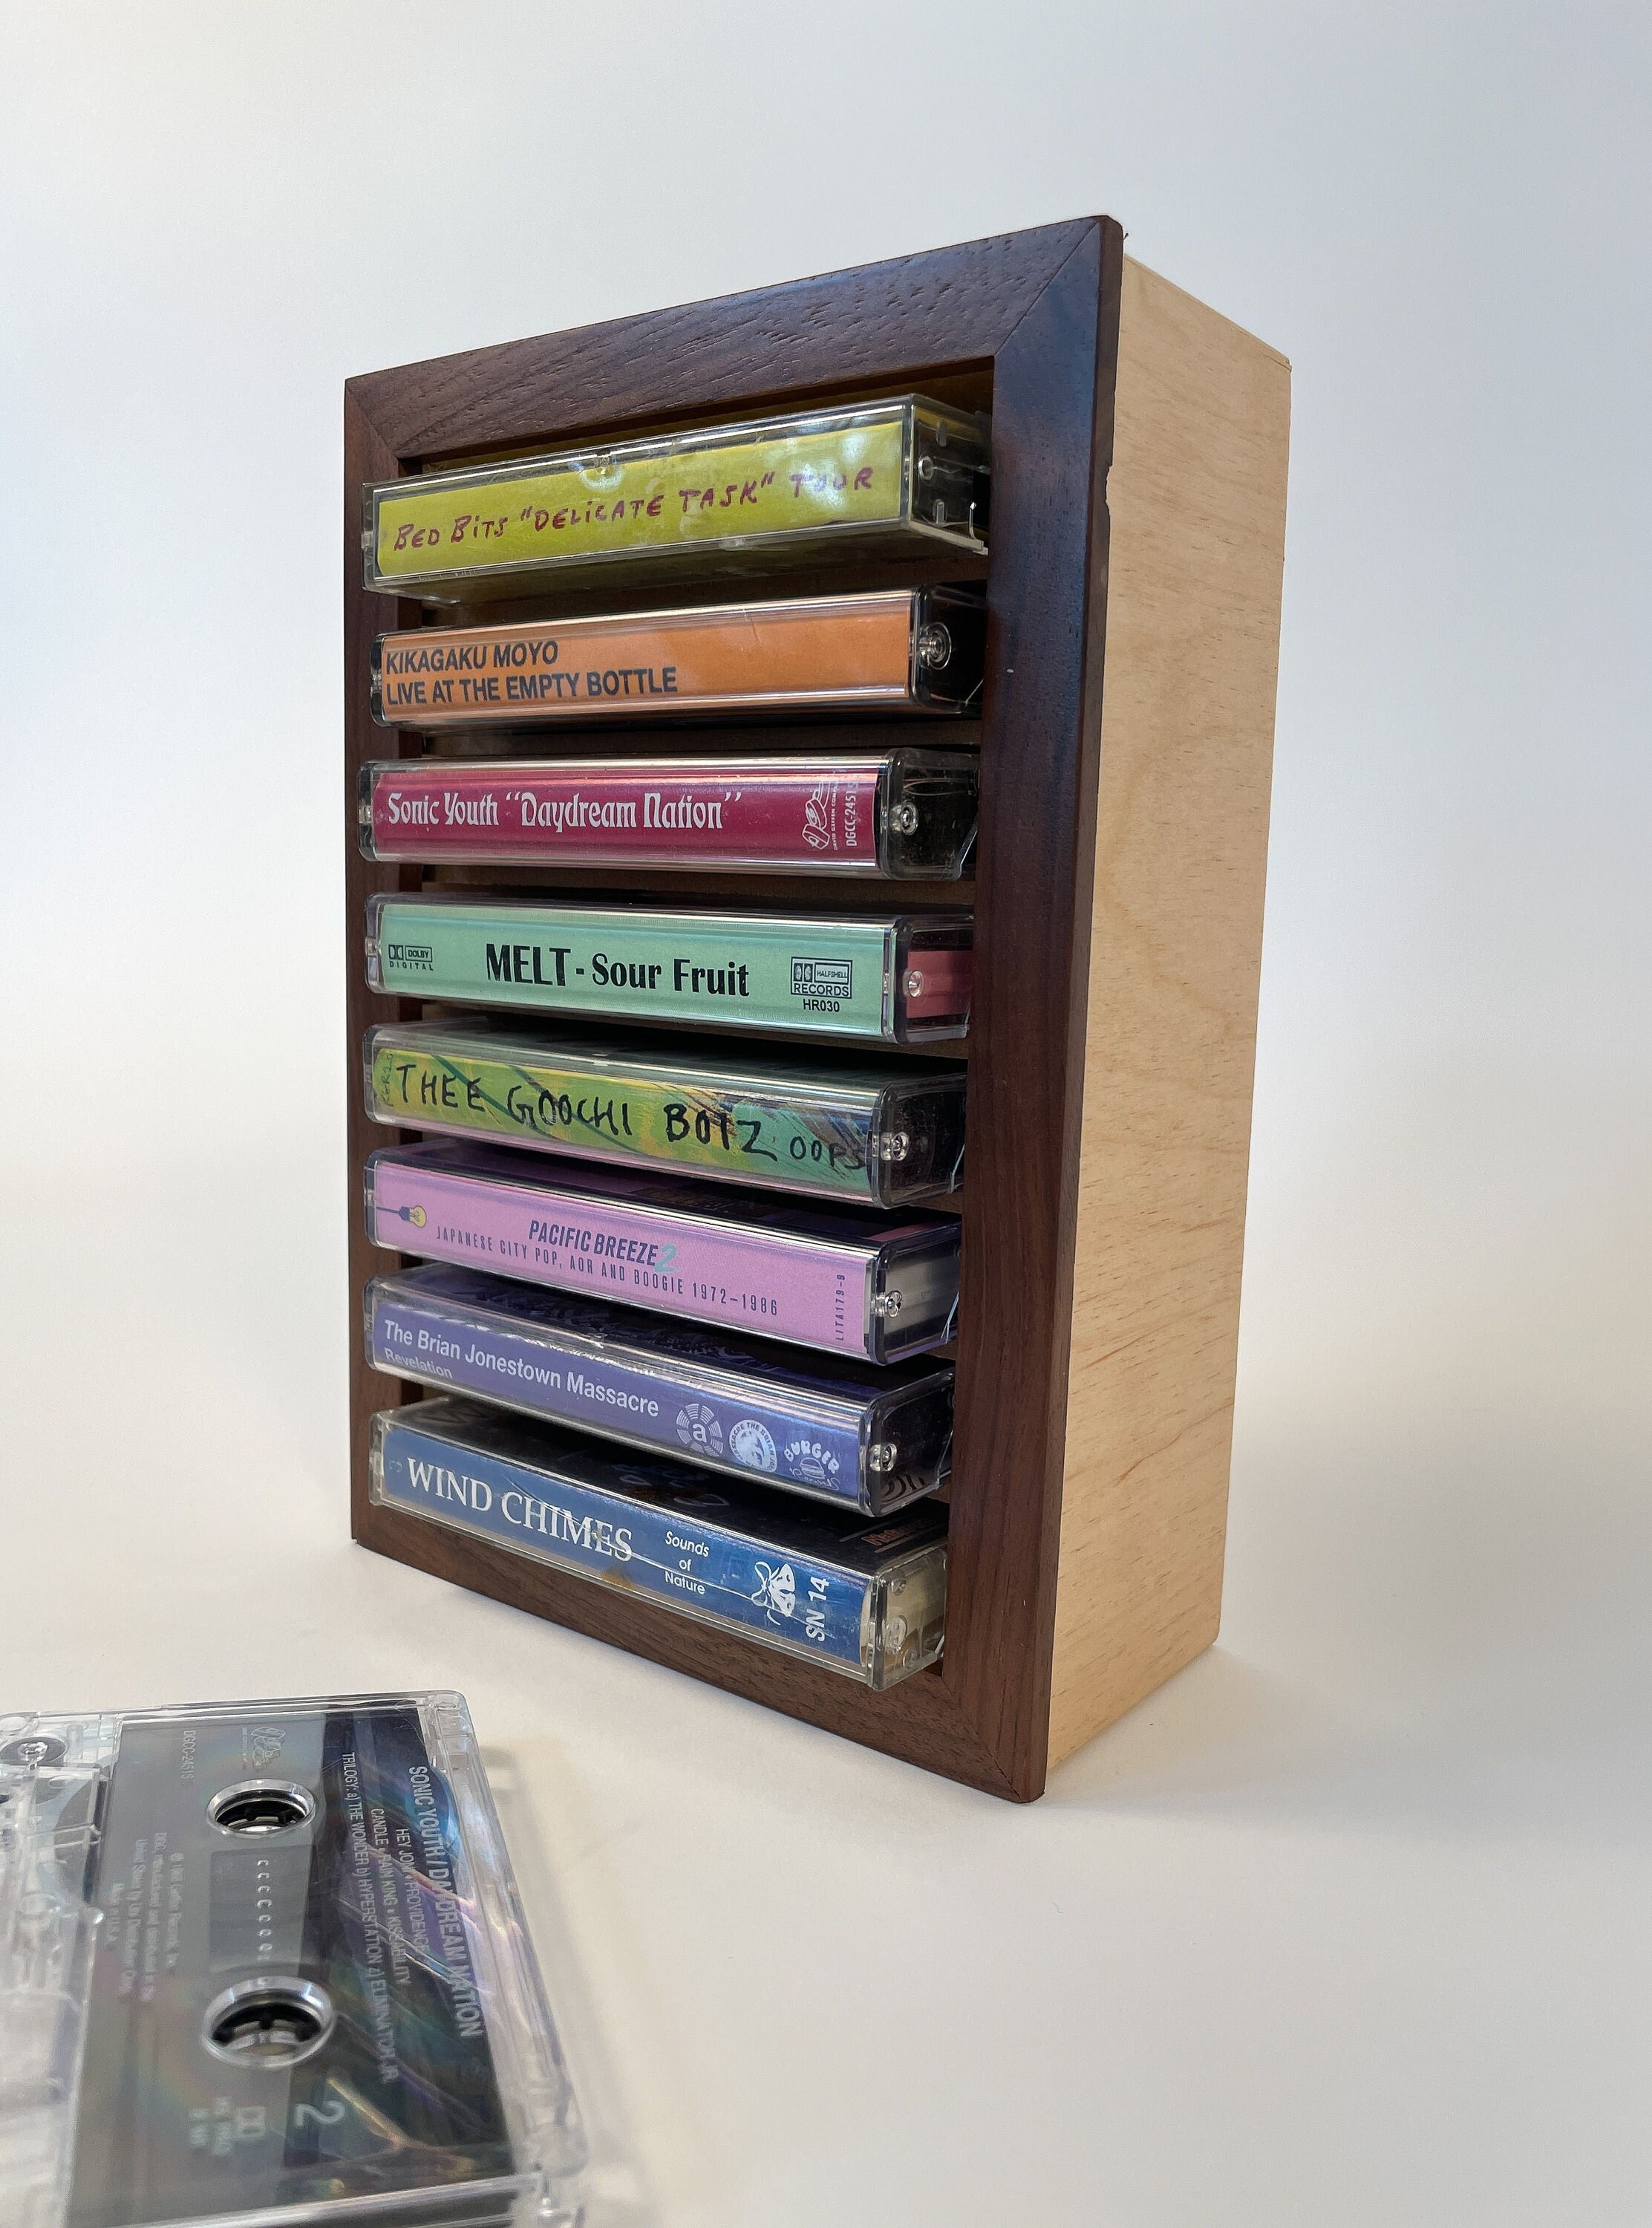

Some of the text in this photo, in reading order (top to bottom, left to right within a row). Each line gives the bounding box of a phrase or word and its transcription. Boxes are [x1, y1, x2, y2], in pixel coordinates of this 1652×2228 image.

[394, 523, 440, 551] BED
[386, 640, 558, 674] KIKAGAKU MOYO
[387, 666, 678, 706] LIVE AT THE EMPTY BOTTLE
[388, 792, 440, 824] Sonic
[444, 792, 499, 825] Youth
[389, 961, 434, 971] DIGITAL
[408, 948, 429, 959] DOLBY
[486, 943, 571, 986] MELT
[592, 953, 662, 989] Sour
[673, 958, 750, 997] Fruit
[794, 984, 849, 997] RECORDS
[817, 970, 848, 980] HALFSHELL
[803, 1000, 840, 1013] HR030
[396, 1063, 486, 1113] THEE
[506, 1085, 633, 1136] GOOCHI
[436, 1225, 493, 1251] JAPANESE
[500, 1240, 527, 1259] CITY
[535, 1248, 562, 1268] POP,
[570, 1256, 593, 1274] AOR
[601, 1263, 625, 1281] AND
[634, 1269, 683, 1294] BOOGIE
[529, 1219, 680, 1273] PACIFIC BREEZE 2
[835, 1274, 846, 1341] LITA179-9
[385, 1347, 453, 1379] Revelation
[385, 1320, 659, 1416] The Brian Jonestown Massacre
[693, 1424, 707, 1442] a
[746, 1421, 760, 1431] THE
[760, 1429, 774, 1456] BRIAN
[783, 1440, 840, 1473] BURGER
[407, 1457, 632, 1562] WIND CHIMES
[665, 1531, 710, 1557] Sounds
[679, 1559, 692, 1571] of
[665, 1571, 705, 1595] Nature
[806, 1576, 829, 1641] SN 14
[342, 1752, 360, 1791] TRILOGY:
[408, 1765, 435, 1806] SONIC
[345, 1792, 358, 1801] a)
[349, 1801, 365, 1820] THE
[351, 1822, 370, 1866] WONDER
[396, 1828, 413, 1847] HEY
[418, 1808, 446, 1857] YOUTH
[370, 1808, 389, 1846] CANDLE
[381, 1880, 399, 1906] KING
[428, 1868, 468, 1959] DADREAM
[448, 1965, 483, 2037] NATION
[294, 2100, 346, 2129] 2
